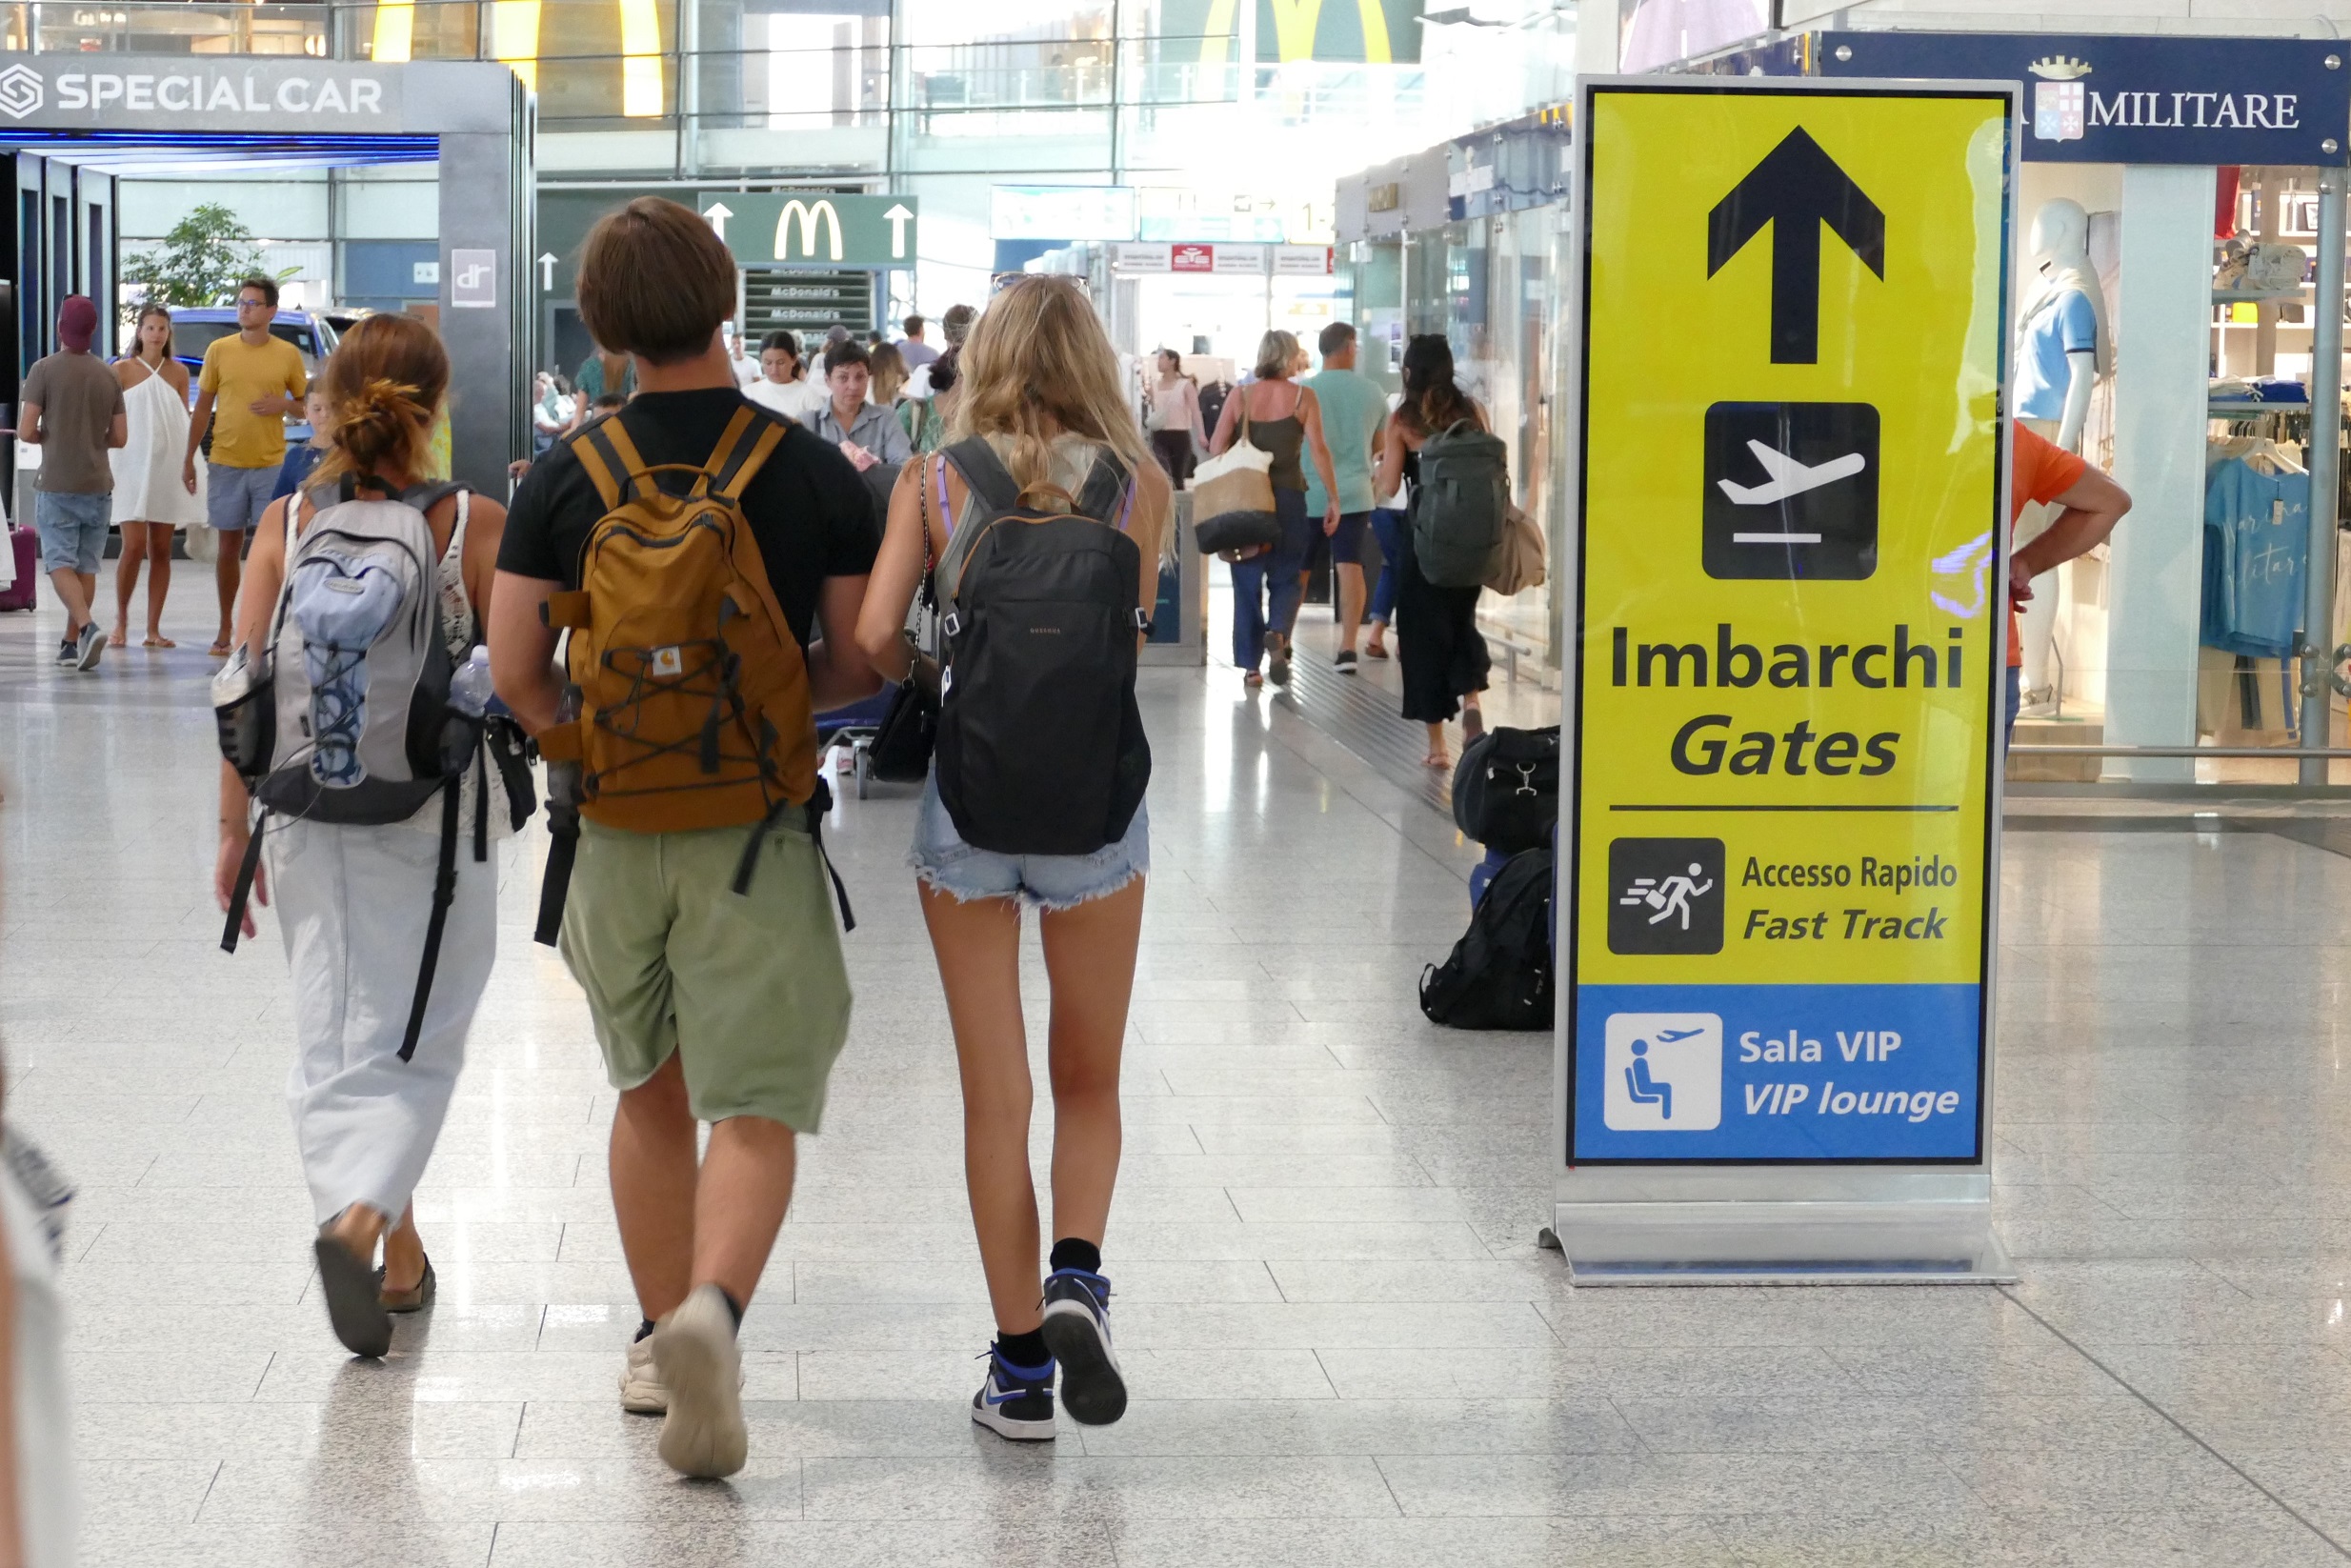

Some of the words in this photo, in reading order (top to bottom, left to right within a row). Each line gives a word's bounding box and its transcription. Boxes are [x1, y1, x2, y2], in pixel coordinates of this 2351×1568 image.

[2087, 91, 2300, 129] MILITARE
[1612, 623, 1962, 689] Imbarchi
[1670, 714, 1899, 776] Gates
[1741, 855, 1851, 887] Accesso
[1860, 854, 1958, 895] Rapido
[1743, 909, 1827, 939] Fast
[1842, 907, 1949, 939] Track
[1739, 1029, 1821, 1063] Sala
[1837, 1031, 1901, 1062] VIP
[1745, 1083, 1809, 1115] VIP
[1819, 1081, 1959, 1123] lounge
